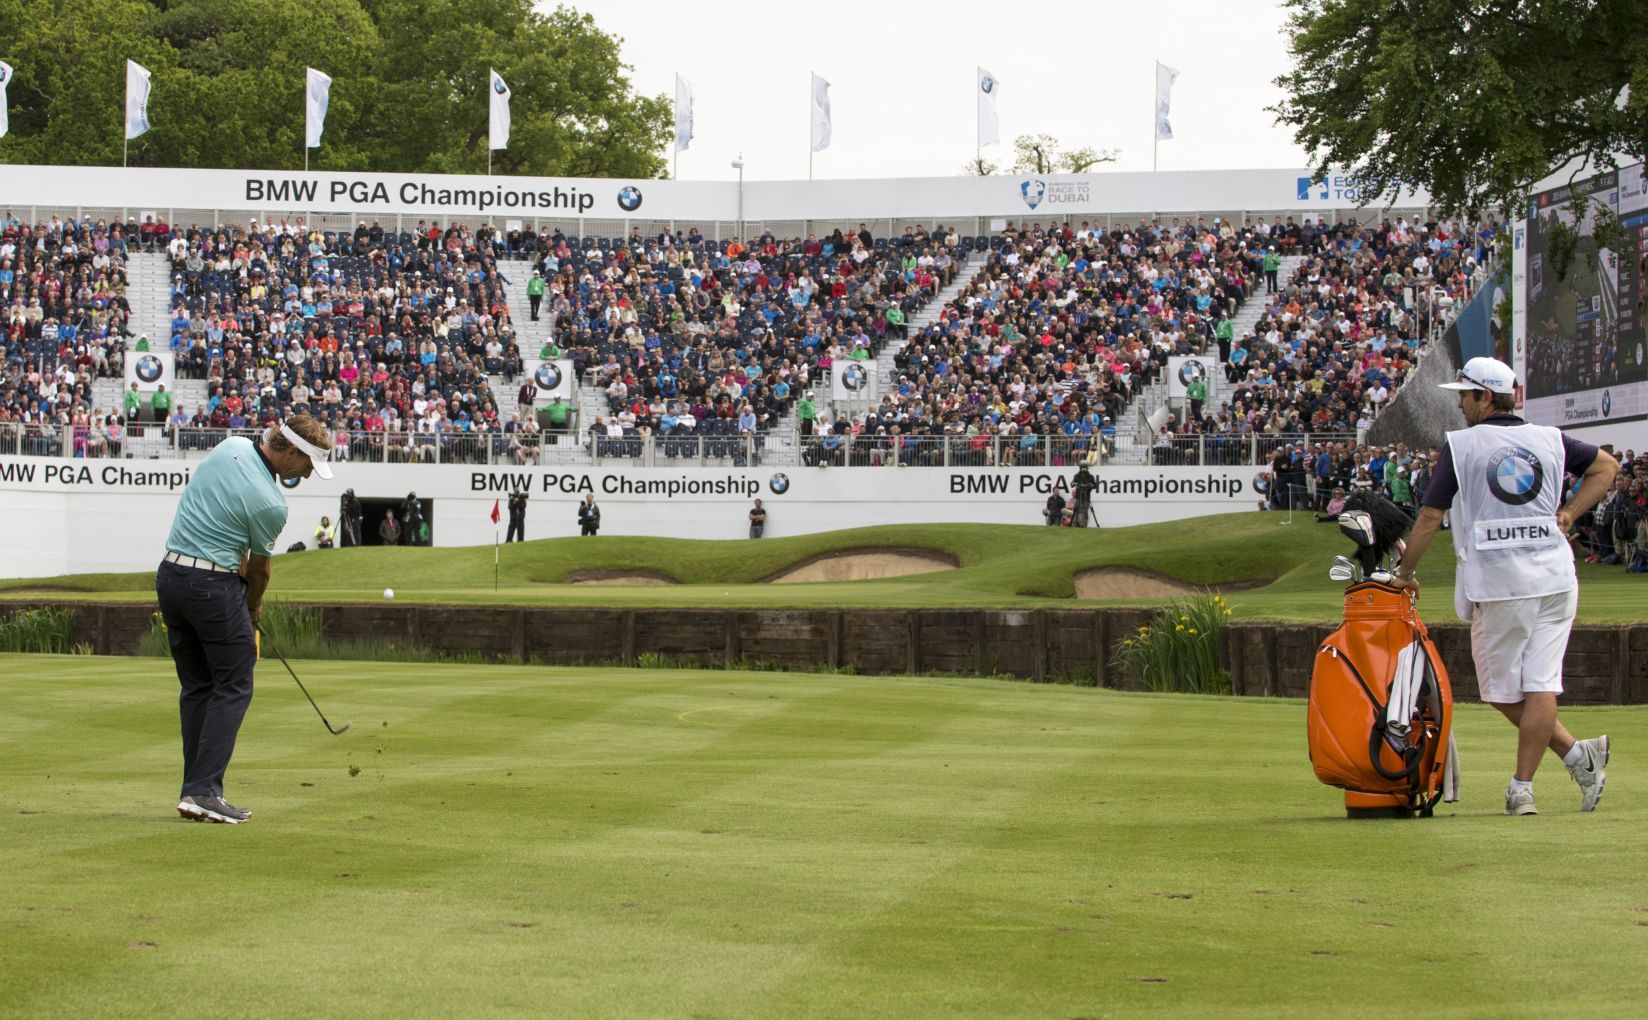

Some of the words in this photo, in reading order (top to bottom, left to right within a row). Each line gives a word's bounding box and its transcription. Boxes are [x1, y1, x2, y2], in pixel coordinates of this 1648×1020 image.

[246, 179, 318, 202] BMW
[330, 181, 391, 204] PGA
[399, 182, 594, 214] Championship
[1048, 186, 1075, 194] RACE
[1048, 193, 1090, 203] DUBAI
[45, 465, 94, 485] PGA
[471, 472, 533, 491] BMW
[543, 473, 594, 493] PGA
[602, 475, 760, 498] Championship
[950, 474, 1010, 494] BMW
[1019, 474, 1070, 494] PGA
[1094, 474, 1243, 498] hampionship
[1486, 525, 1550, 541] LUITEN
